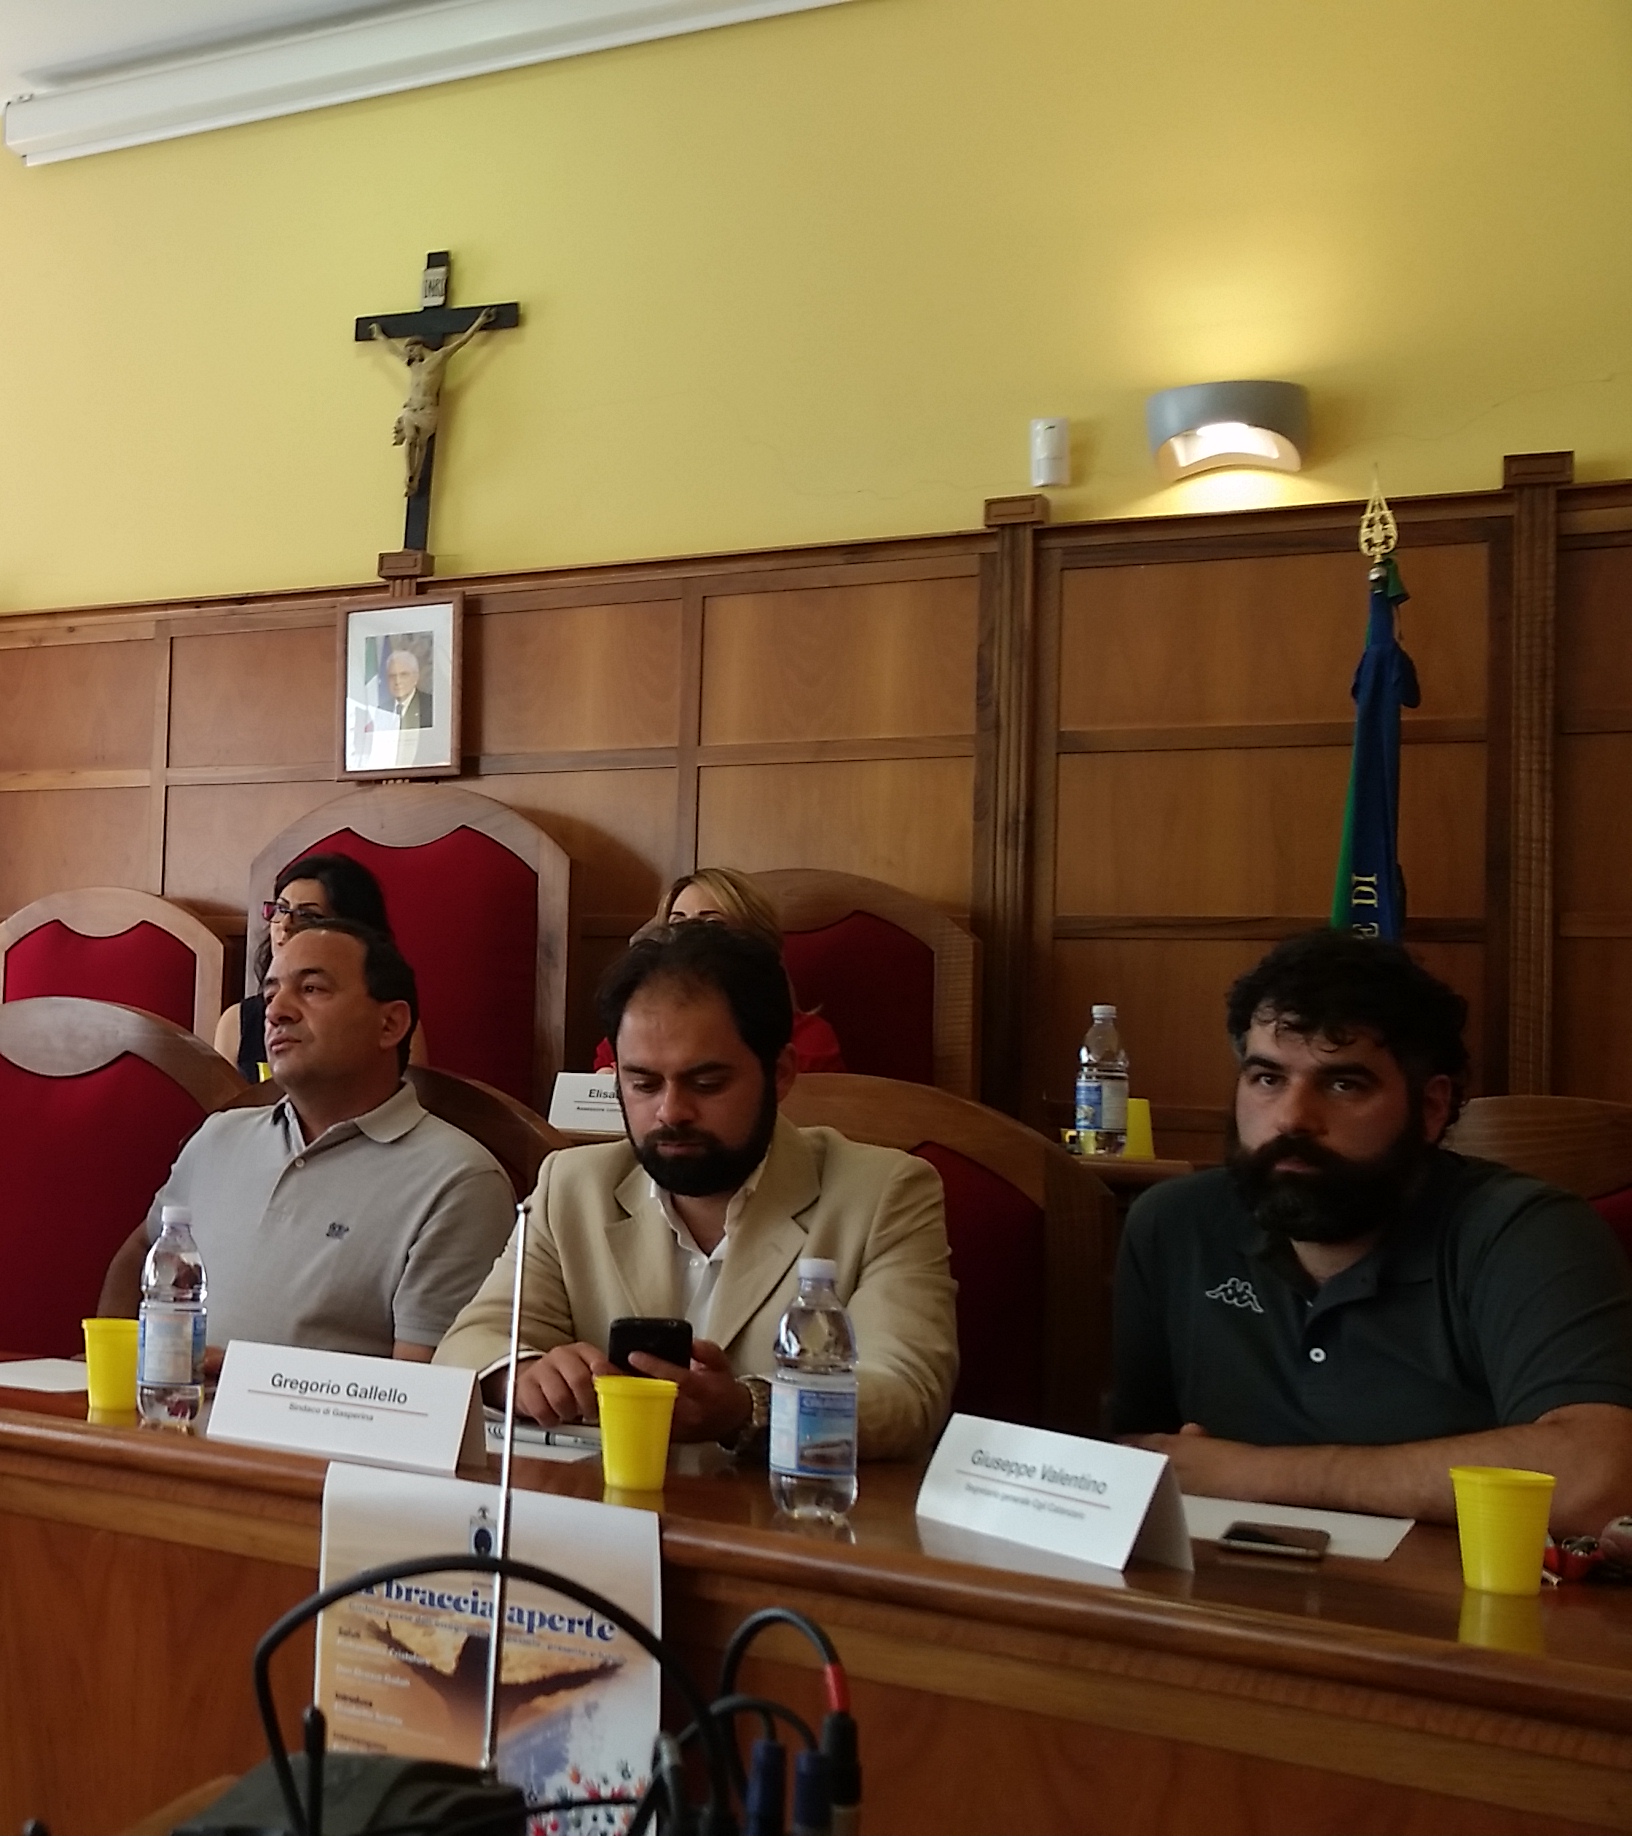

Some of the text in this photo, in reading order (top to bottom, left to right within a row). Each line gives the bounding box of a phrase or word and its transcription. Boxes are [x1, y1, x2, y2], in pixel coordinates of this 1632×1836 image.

[1351, 872, 1378, 908] DI
[270, 1372, 409, 1405] Gregorio Gallello
[288, 1402, 321, 1414] Sindaco
[331, 1408, 374, 1422] Gasperina
[971, 1449, 1108, 1495] Giuseppe Valentino
[384, 1578, 618, 1643] braccia aperte
